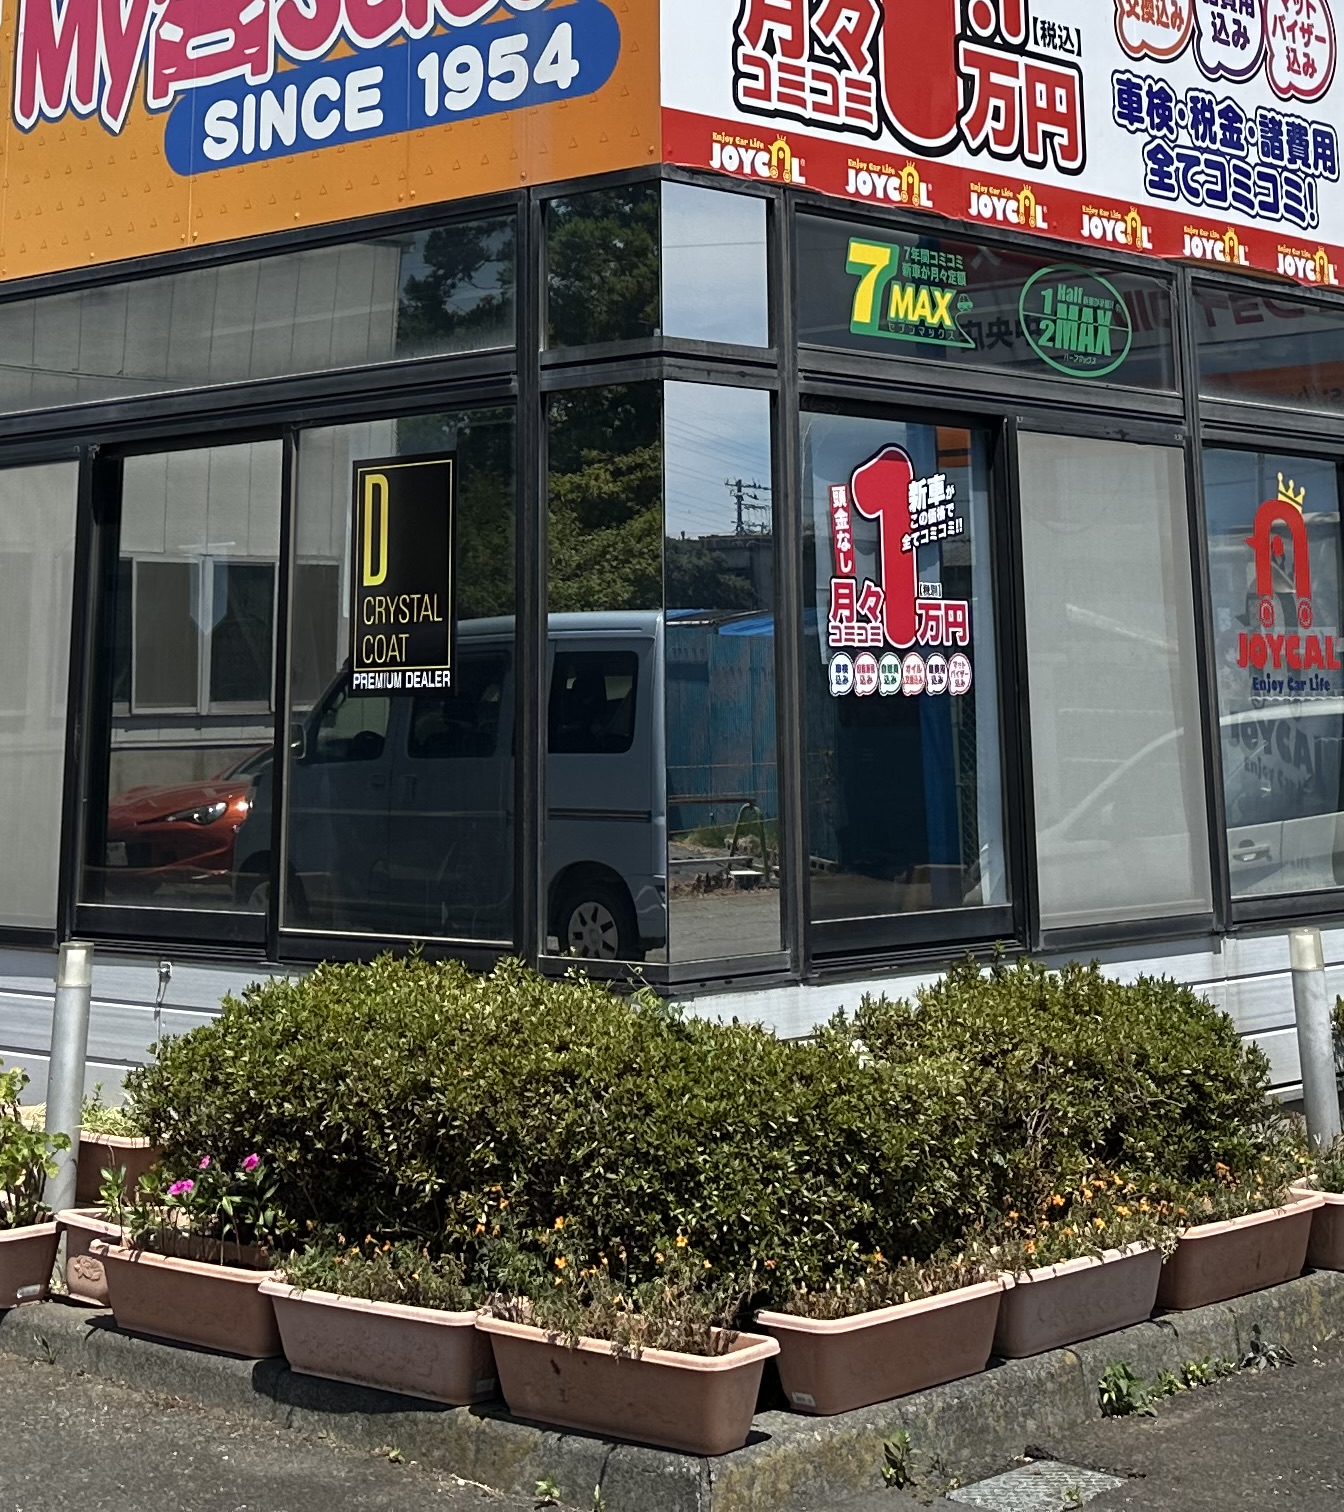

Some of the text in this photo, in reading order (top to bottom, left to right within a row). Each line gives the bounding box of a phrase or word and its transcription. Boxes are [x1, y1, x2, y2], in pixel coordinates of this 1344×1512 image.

[1210, 11, 1250, 50] 込み
[1271, 14, 1327, 47] バイザー
[1285, 47, 1317, 79] 込み
[202, 23, 580, 162] SINCE 1954
[739, 50, 878, 129] コミコミ
[962, 48, 1083, 172] 万円
[1115, 76, 1337, 178] 車検・税金・諸費用
[709, 140, 806, 184] JOYCAL
[845, 166, 933, 208] JOYCAL
[968, 190, 1048, 229] JOYCAL
[1081, 210, 1153, 251] JOYCAL
[1182, 230, 1249, 267] JOYCAL
[902, 262, 967, 286] 新車が月々定額
[904, 246, 964, 270] 7年間コミコミ
[1277, 250, 1338, 286] JOYCAL
[889, 283, 954, 327] MAX
[1058, 283, 1083, 304] Half
[888, 322, 955, 340] セブンマックス
[1055, 302, 1112, 356] MAX
[908, 474, 955, 513] 新車が
[363, 474, 389, 586] D
[831, 486, 852, 574] 頭金なし
[910, 502, 955, 530] この価格で
[364, 593, 443, 625] CRYSTAL
[830, 578, 884, 625] 月々
[829, 623, 884, 647] コミコミ
[916, 601, 969, 646] 万円
[362, 634, 410, 664] COAT
[1237, 632, 1340, 669] JOYCAL
[353, 671, 451, 689] PREMIUM DEALER
[1252, 674, 1331, 695] Enjoy Car Life
